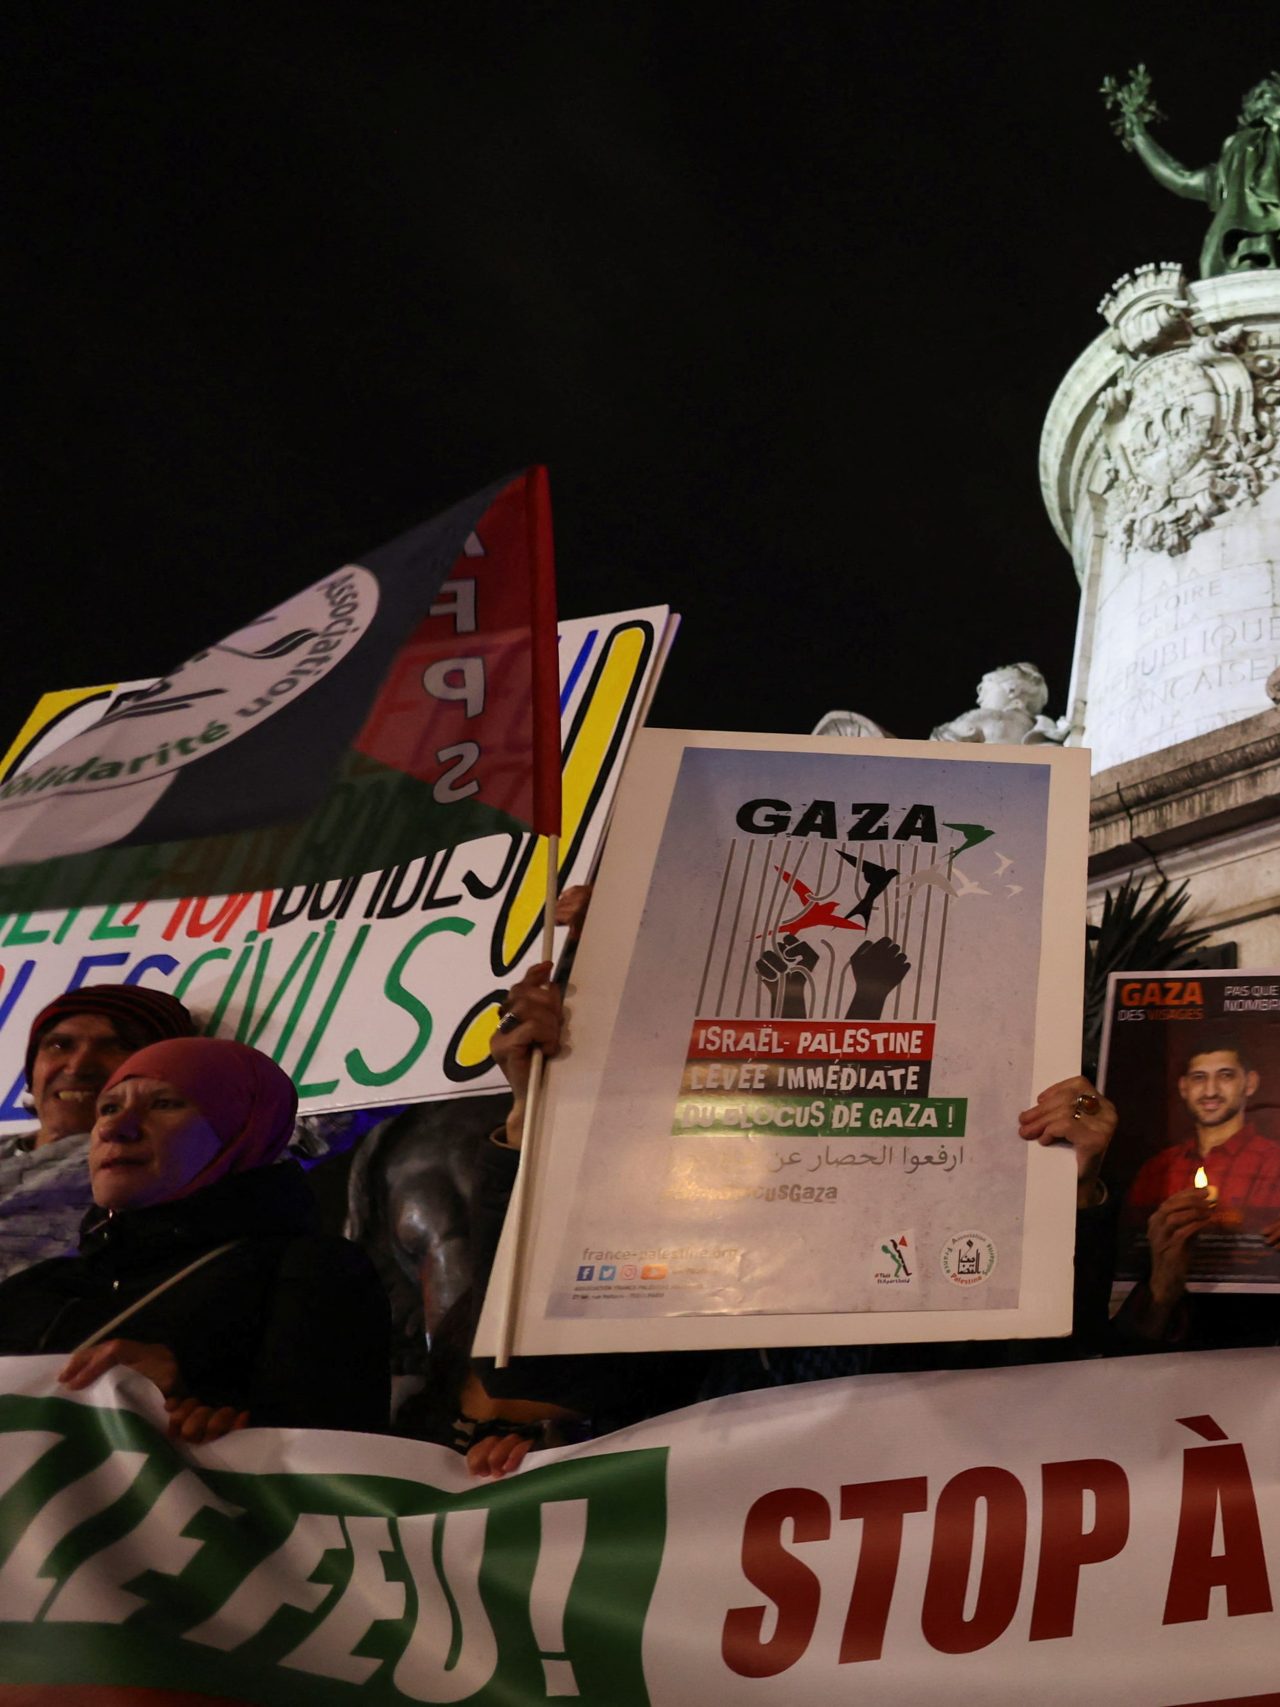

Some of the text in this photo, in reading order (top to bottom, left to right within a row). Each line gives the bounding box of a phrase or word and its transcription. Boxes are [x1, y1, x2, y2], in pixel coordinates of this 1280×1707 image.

[0, 717, 232, 802] olidarité
[735, 797, 940, 844] GAZA
[1120, 981, 1205, 1007] GAZA
[1224, 985, 1250, 997] PAS
[1252, 985, 1279, 997] QUE
[1117, 1008, 1146, 1022] DES
[797, 1028, 924, 1055] PALESTINE
[777, 1058, 921, 1092] IMMÉDIATE
[682, 1103, 717, 1129] DU
[722, 1100, 826, 1130] BLOCUS
[831, 1101, 865, 1129] DE
[868, 1102, 939, 1130] GAZA
[721, 1458, 1130, 1679] STOP
[1162, 1414, 1274, 1626] À
[181, 1507, 500, 1705] FEU
[528, 1497, 589, 1698] !
